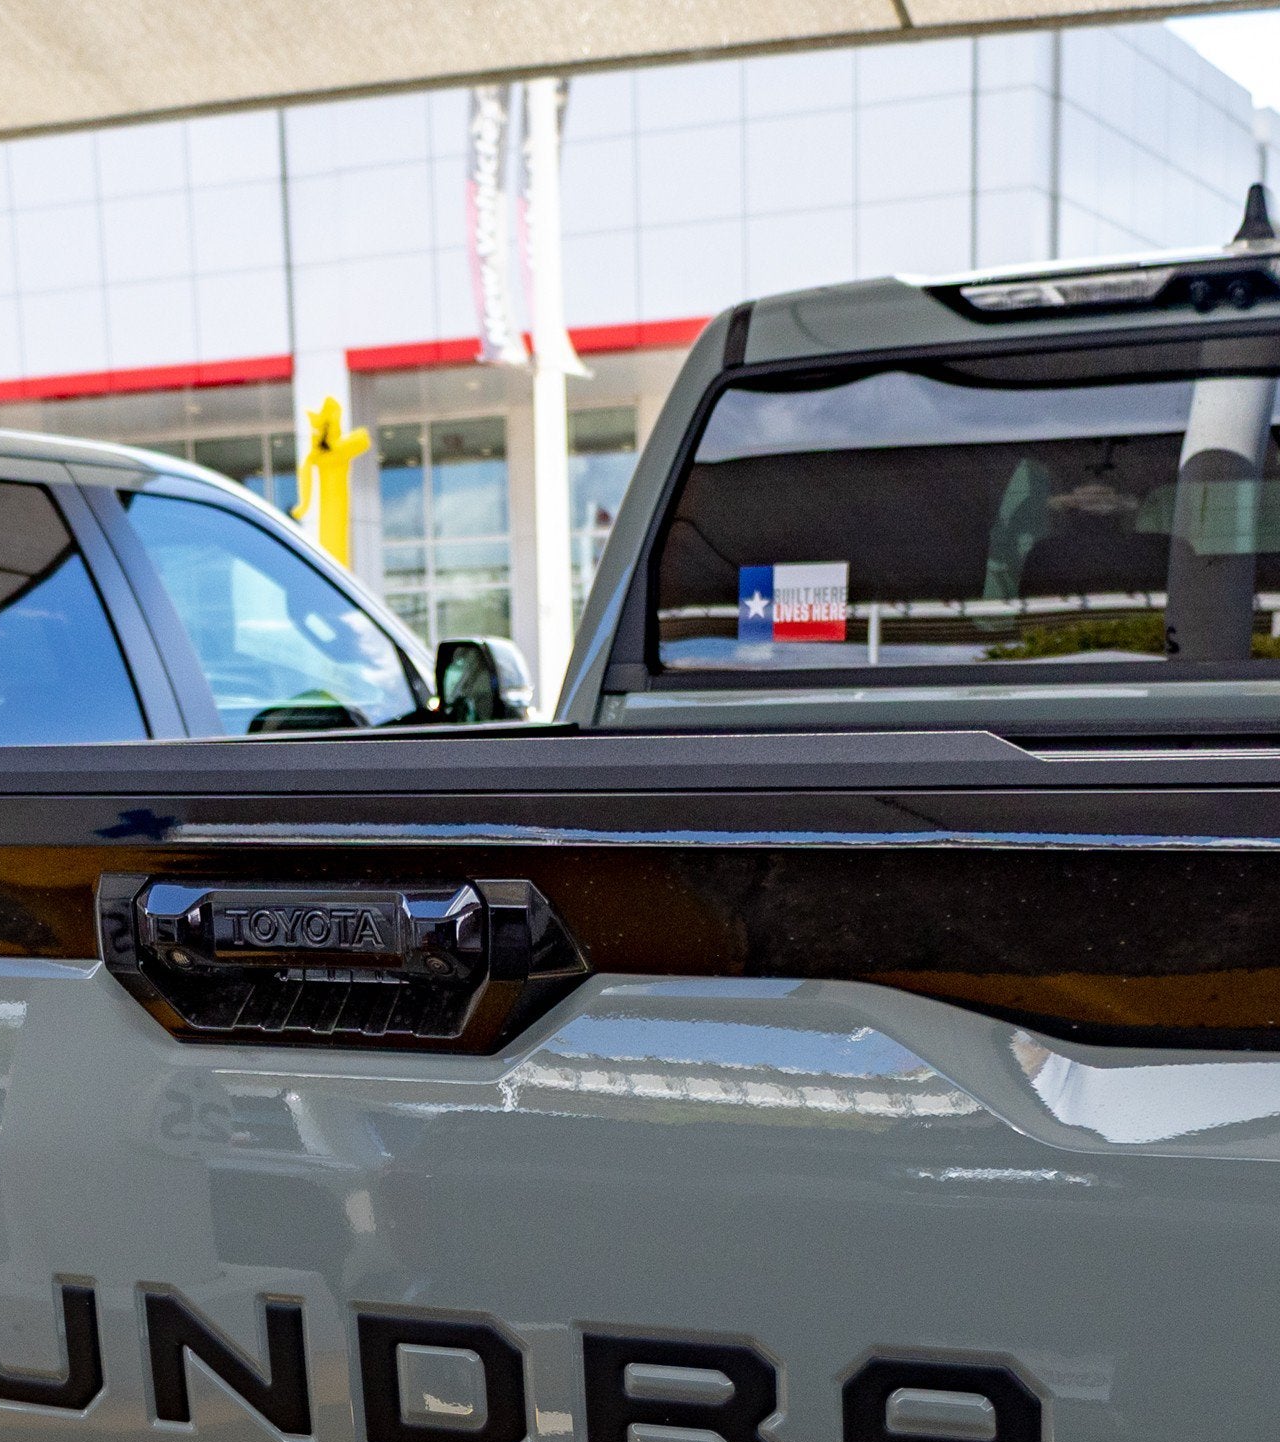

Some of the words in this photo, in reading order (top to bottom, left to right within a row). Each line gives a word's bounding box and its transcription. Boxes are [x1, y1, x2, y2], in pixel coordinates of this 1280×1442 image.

[773, 586, 811, 604] BUILT
[812, 586, 848, 604] HERE
[773, 602, 809, 623] LIVES
[811, 602, 847, 622] HERE
[223, 907, 386, 949] TOYOTA
